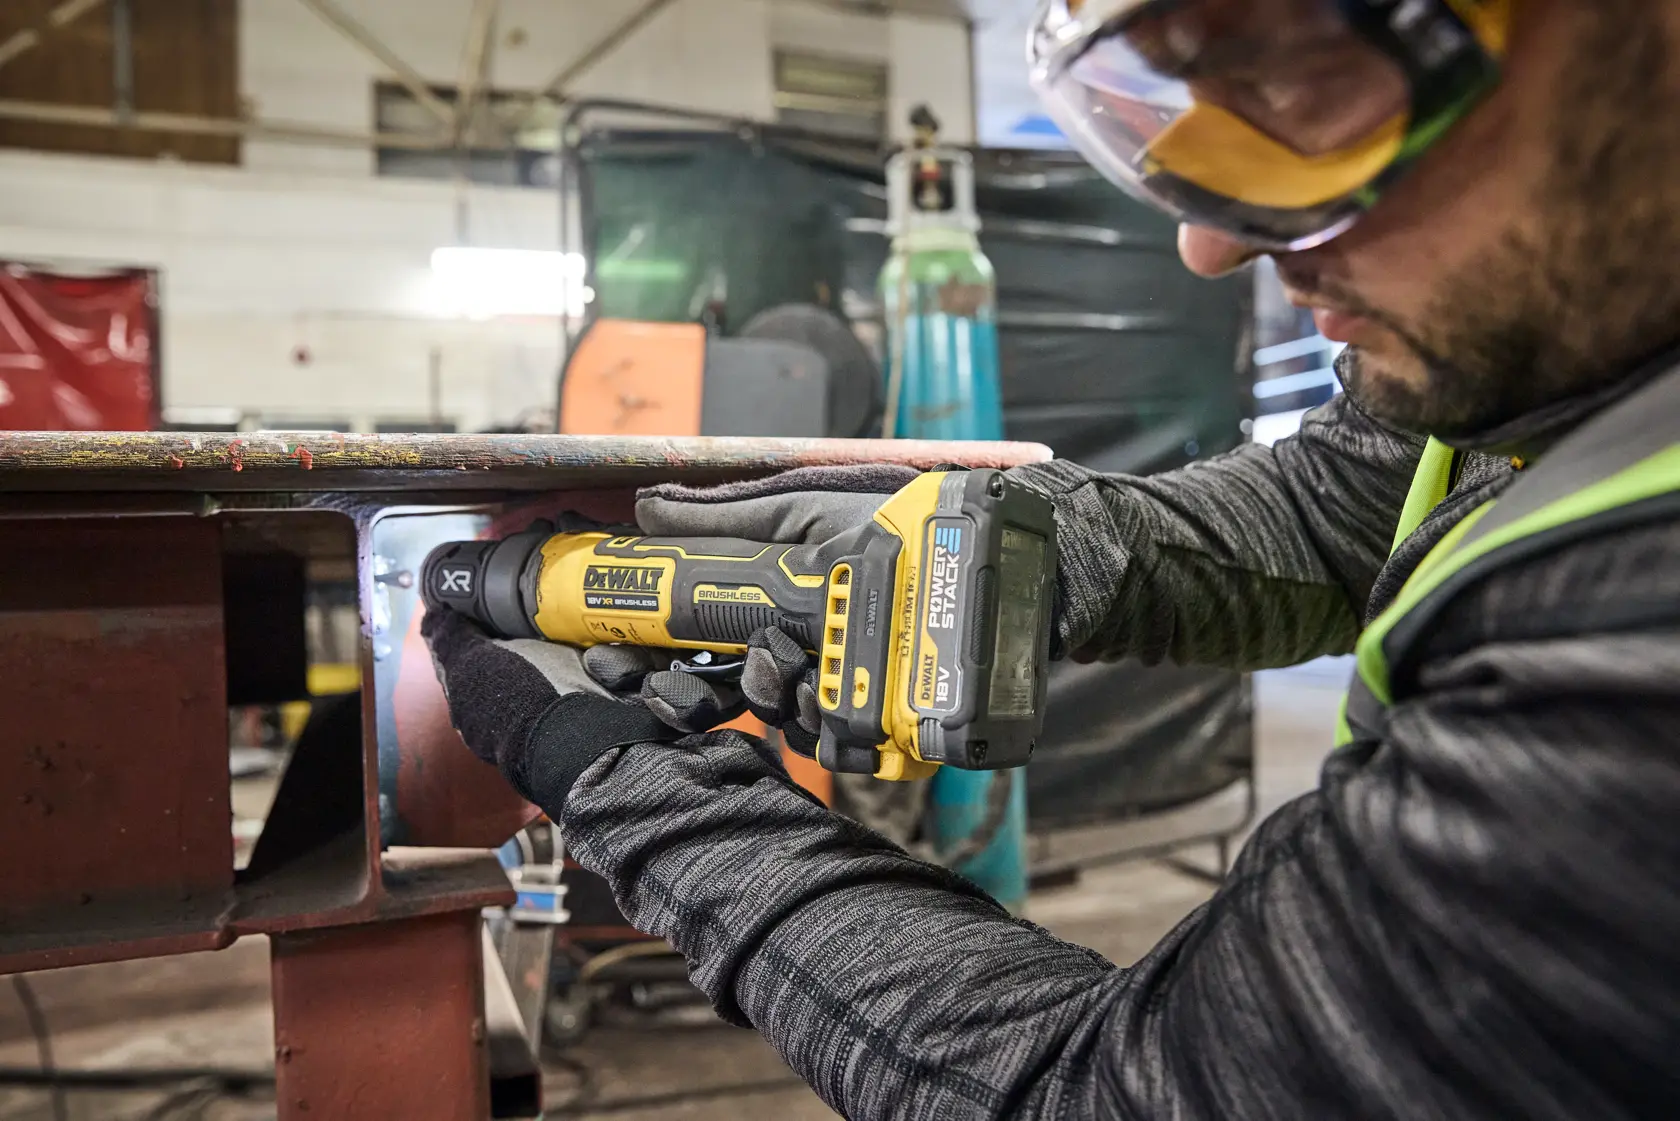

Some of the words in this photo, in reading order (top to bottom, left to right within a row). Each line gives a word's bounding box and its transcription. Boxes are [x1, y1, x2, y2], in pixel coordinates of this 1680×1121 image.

[441, 570, 471, 592] XR
[698, 590, 761, 601] BRUSHLESS
[928, 546, 947, 629] POWER
[941, 554, 960, 630] STACK
[587, 597, 601, 605] 18V
[602, 597, 613, 606] XR
[614, 599, 657, 607] BRUSHLESS
[935, 666, 950, 702] 18V
